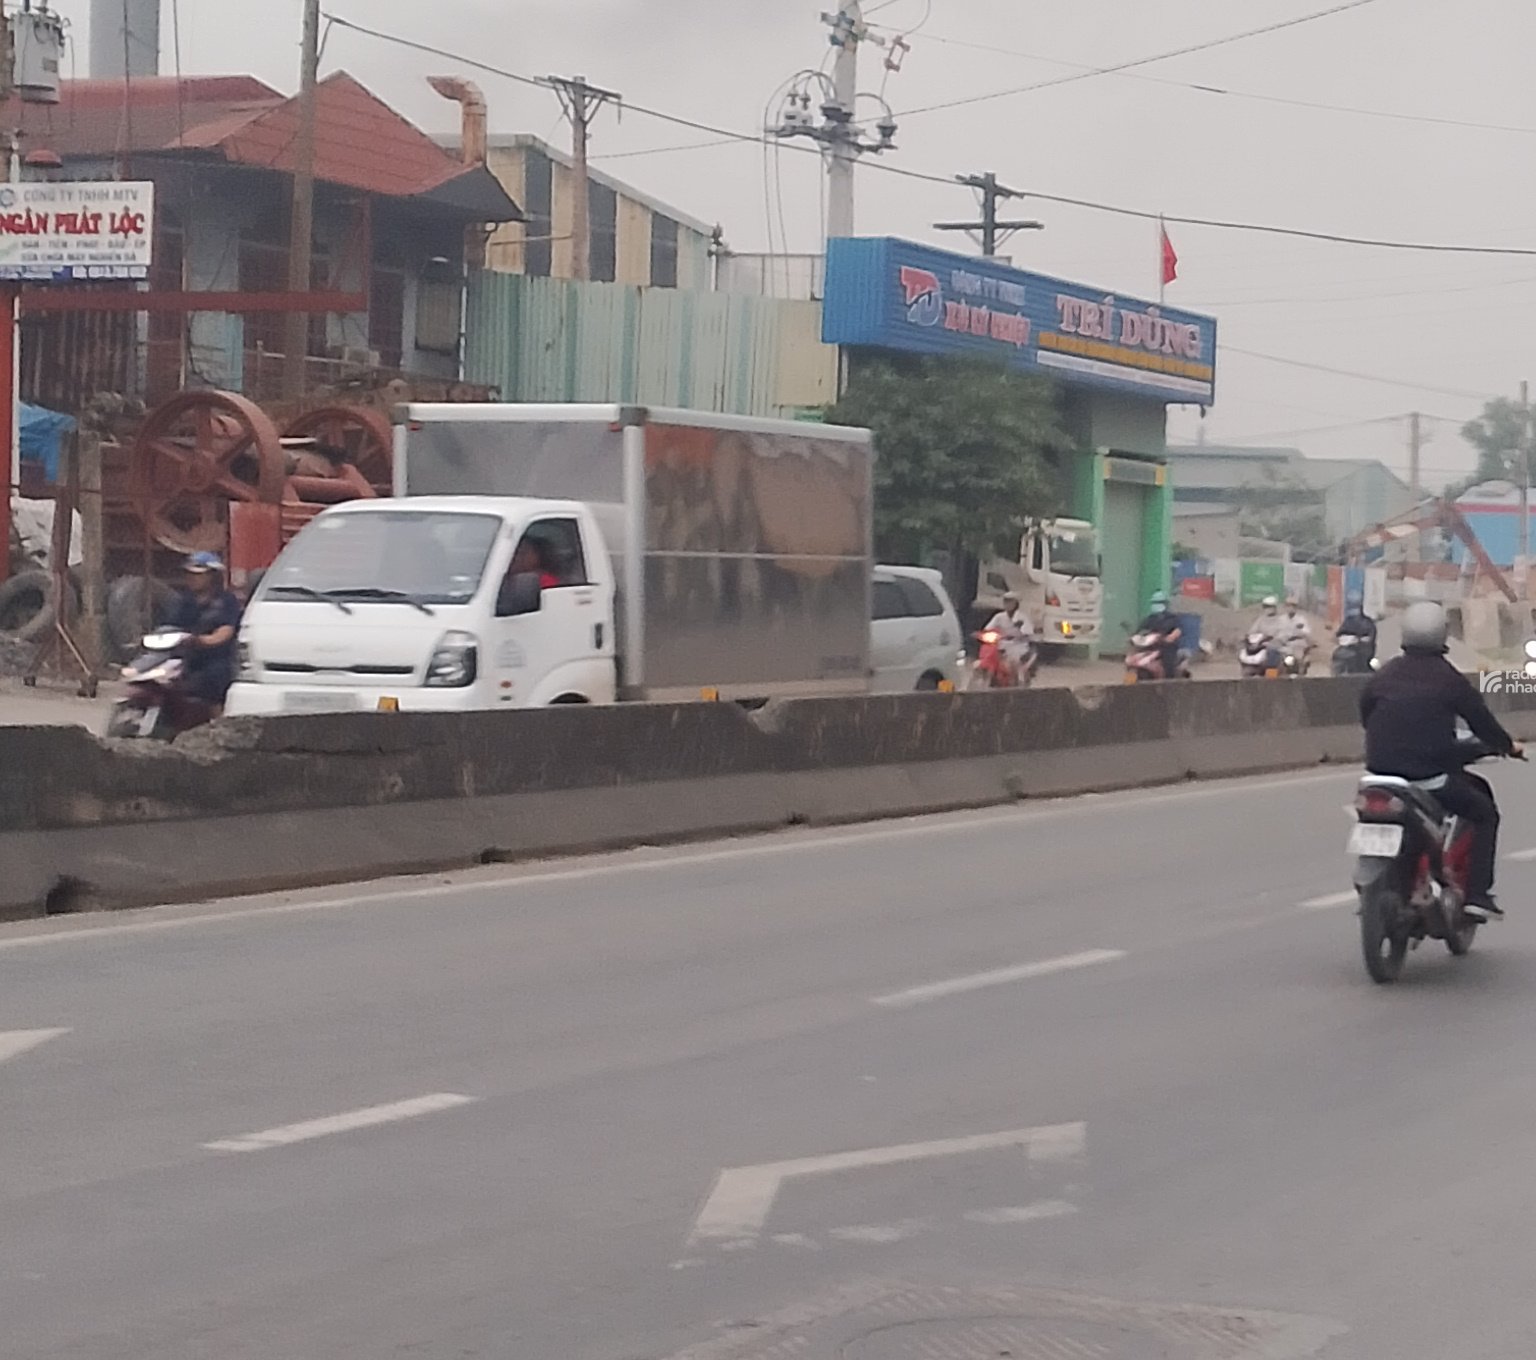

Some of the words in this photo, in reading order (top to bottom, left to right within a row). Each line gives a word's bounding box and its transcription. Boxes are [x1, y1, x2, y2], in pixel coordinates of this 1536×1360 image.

[109, 205, 145, 240] LỘC
[1056, 294, 1115, 341] TRÍ
[1119, 306, 1201, 359] DŨNG
